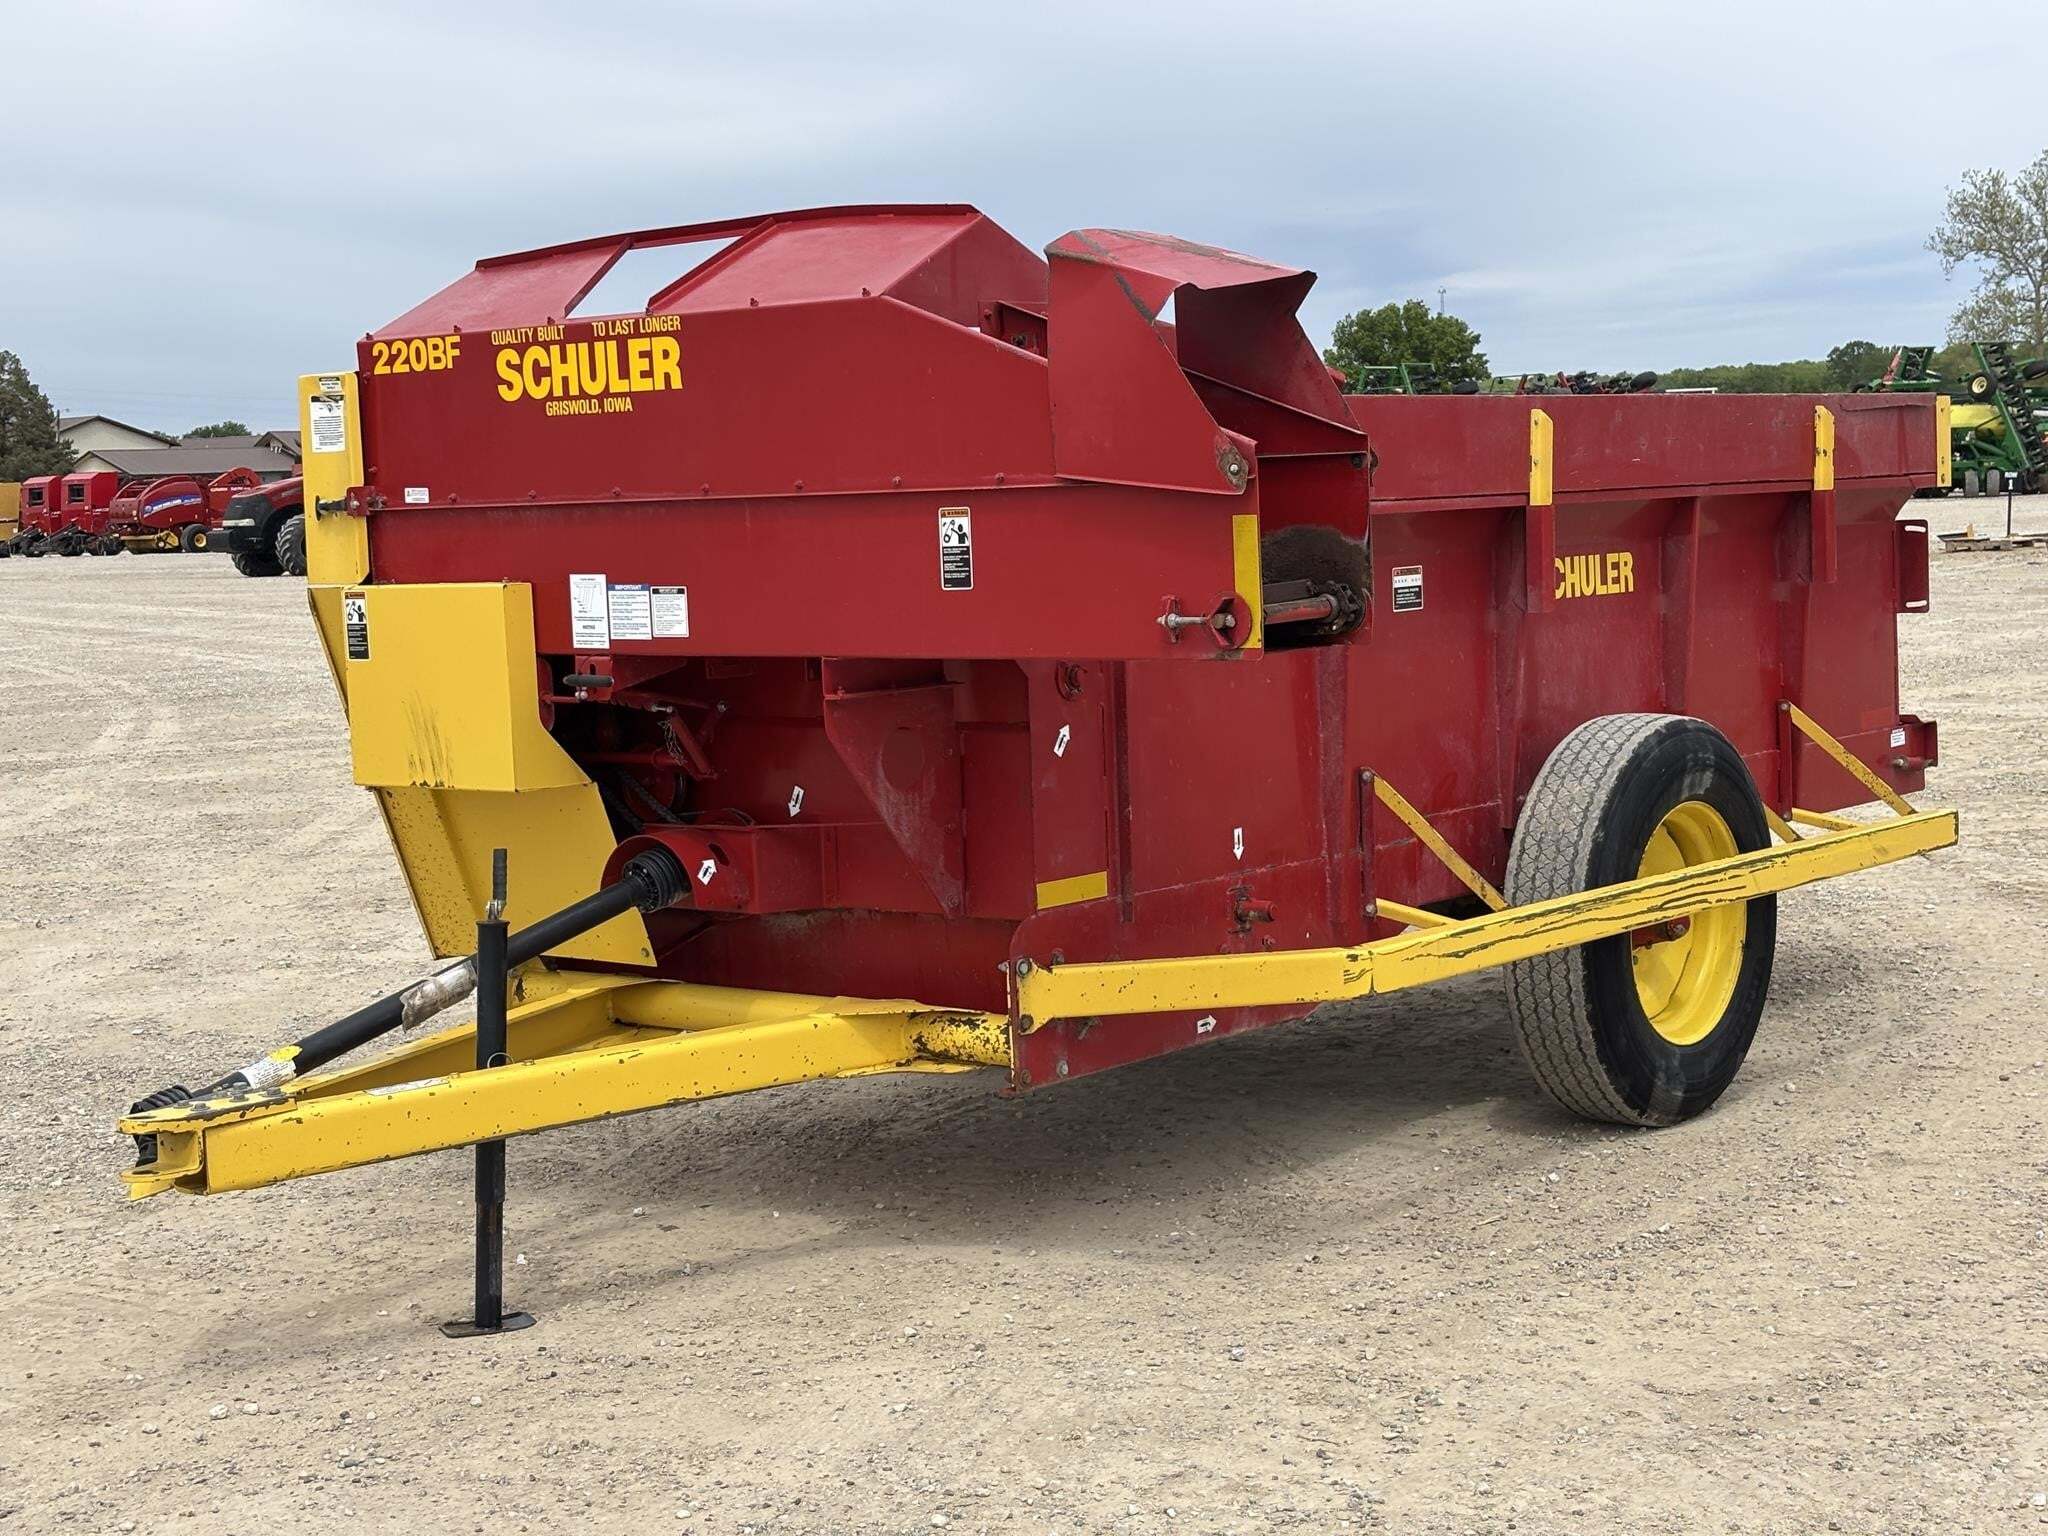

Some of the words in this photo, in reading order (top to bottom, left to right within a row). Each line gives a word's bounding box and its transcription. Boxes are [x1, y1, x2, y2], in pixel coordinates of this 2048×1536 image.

[491, 328, 533, 346] QUALITY
[537, 324, 565, 341] BUILT
[591, 321, 606, 337] TO
[608, 318, 636, 336] LAST
[639, 315, 682, 334] LONGER
[371, 335, 462, 376] 220BF
[495, 336, 683, 402] SCHULER
[545, 398, 602, 417] GRISWOLD,
[604, 396, 633, 413] IOWA
[1554, 551, 1634, 600] CHULER
